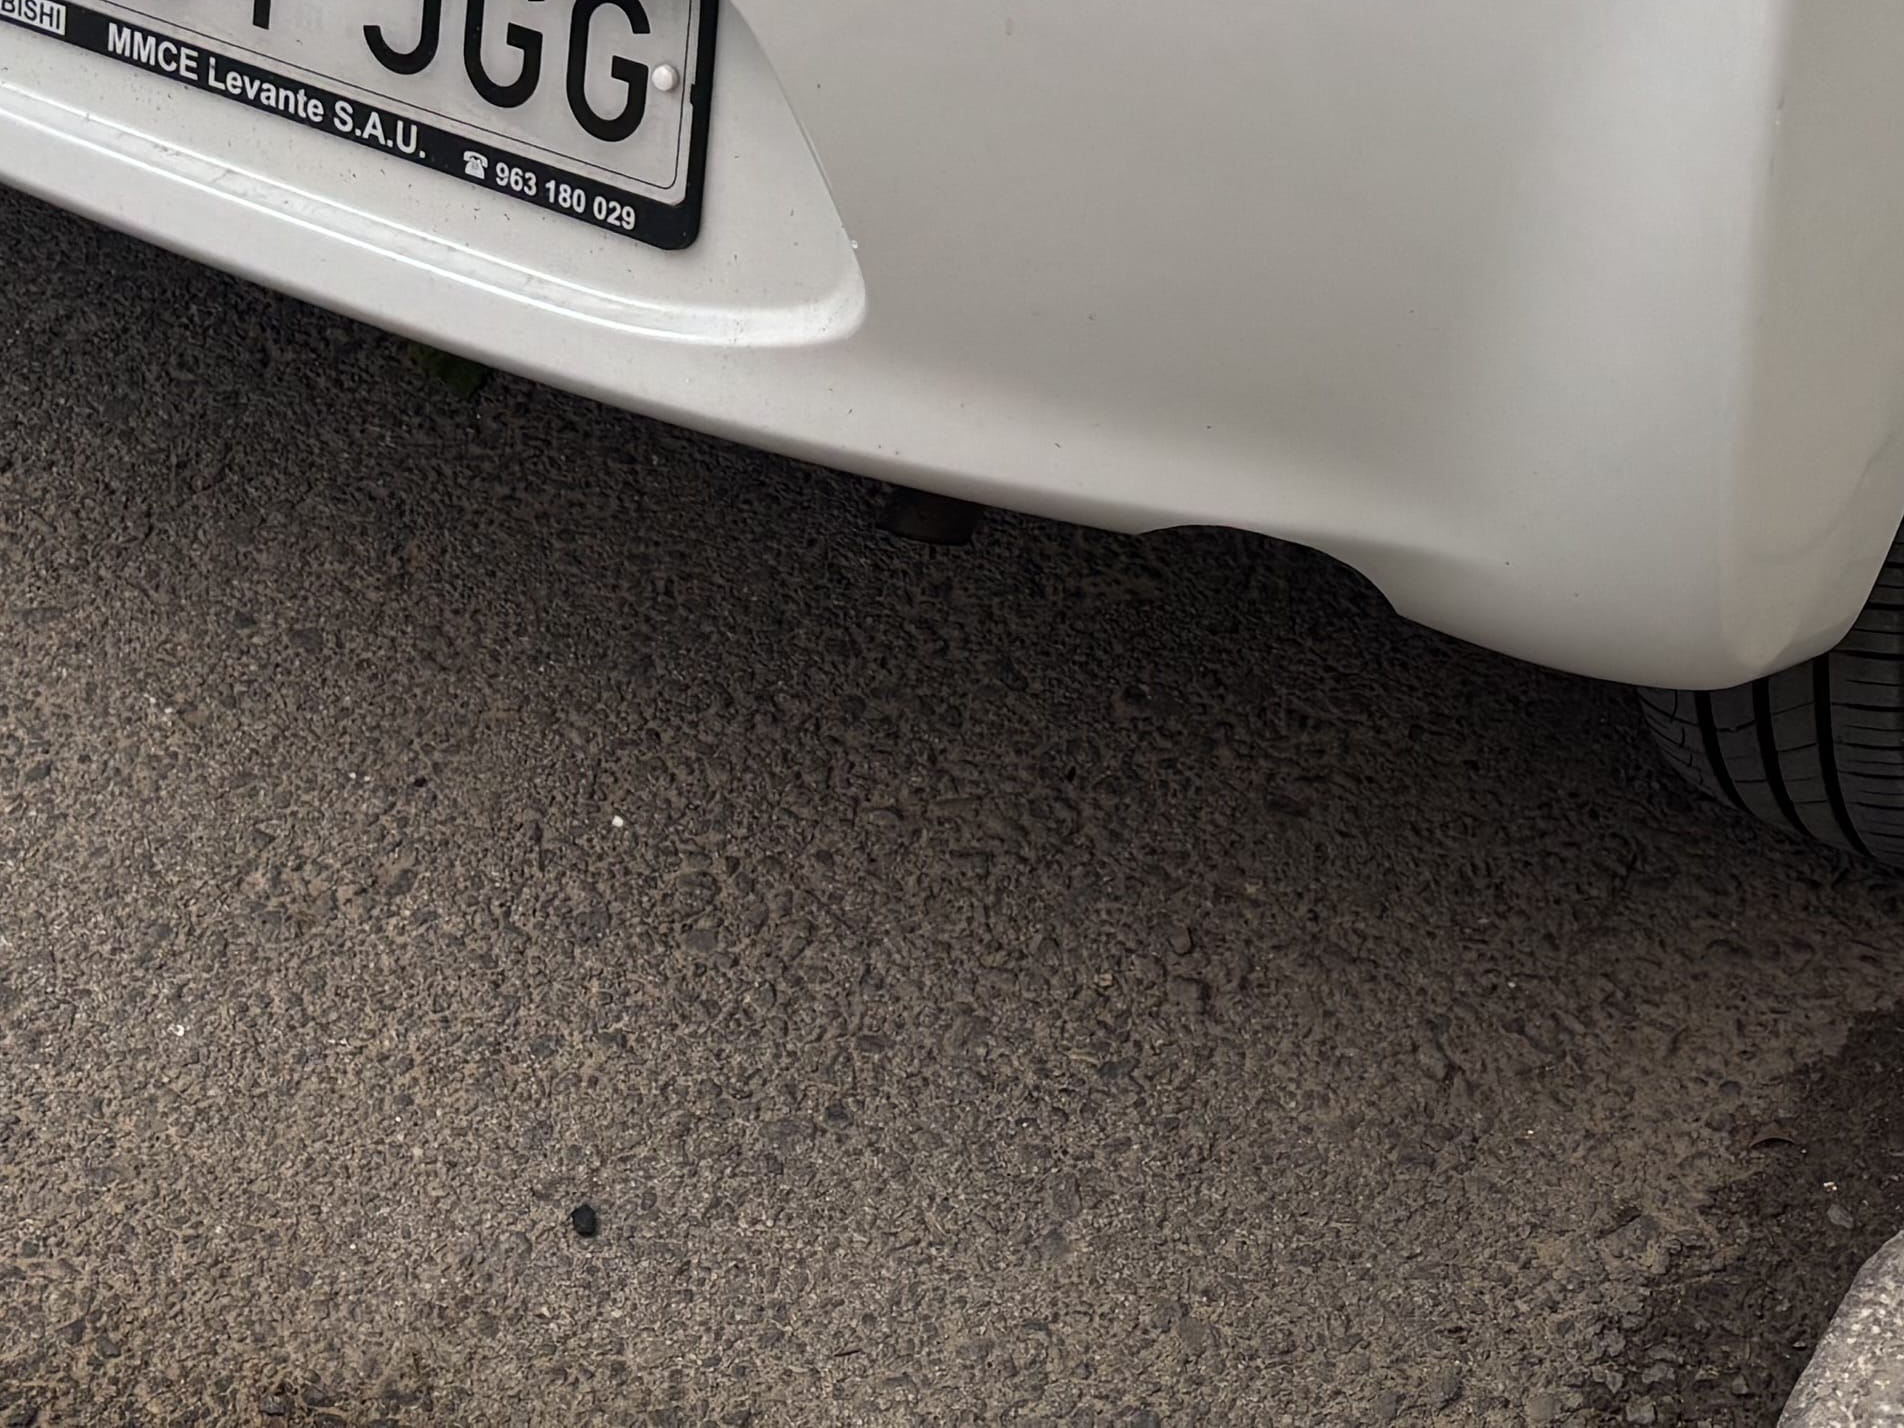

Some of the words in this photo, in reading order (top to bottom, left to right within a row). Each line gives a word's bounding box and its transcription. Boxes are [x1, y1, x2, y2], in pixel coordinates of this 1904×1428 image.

[107, 22, 198, 81] MMCE
[208, 56, 325, 123] Levante
[332, 99, 427, 159] S.A.U.
[495, 162, 538, 197] 963
[545, 179, 587, 214] 180
[593, 195, 636, 231] 029
